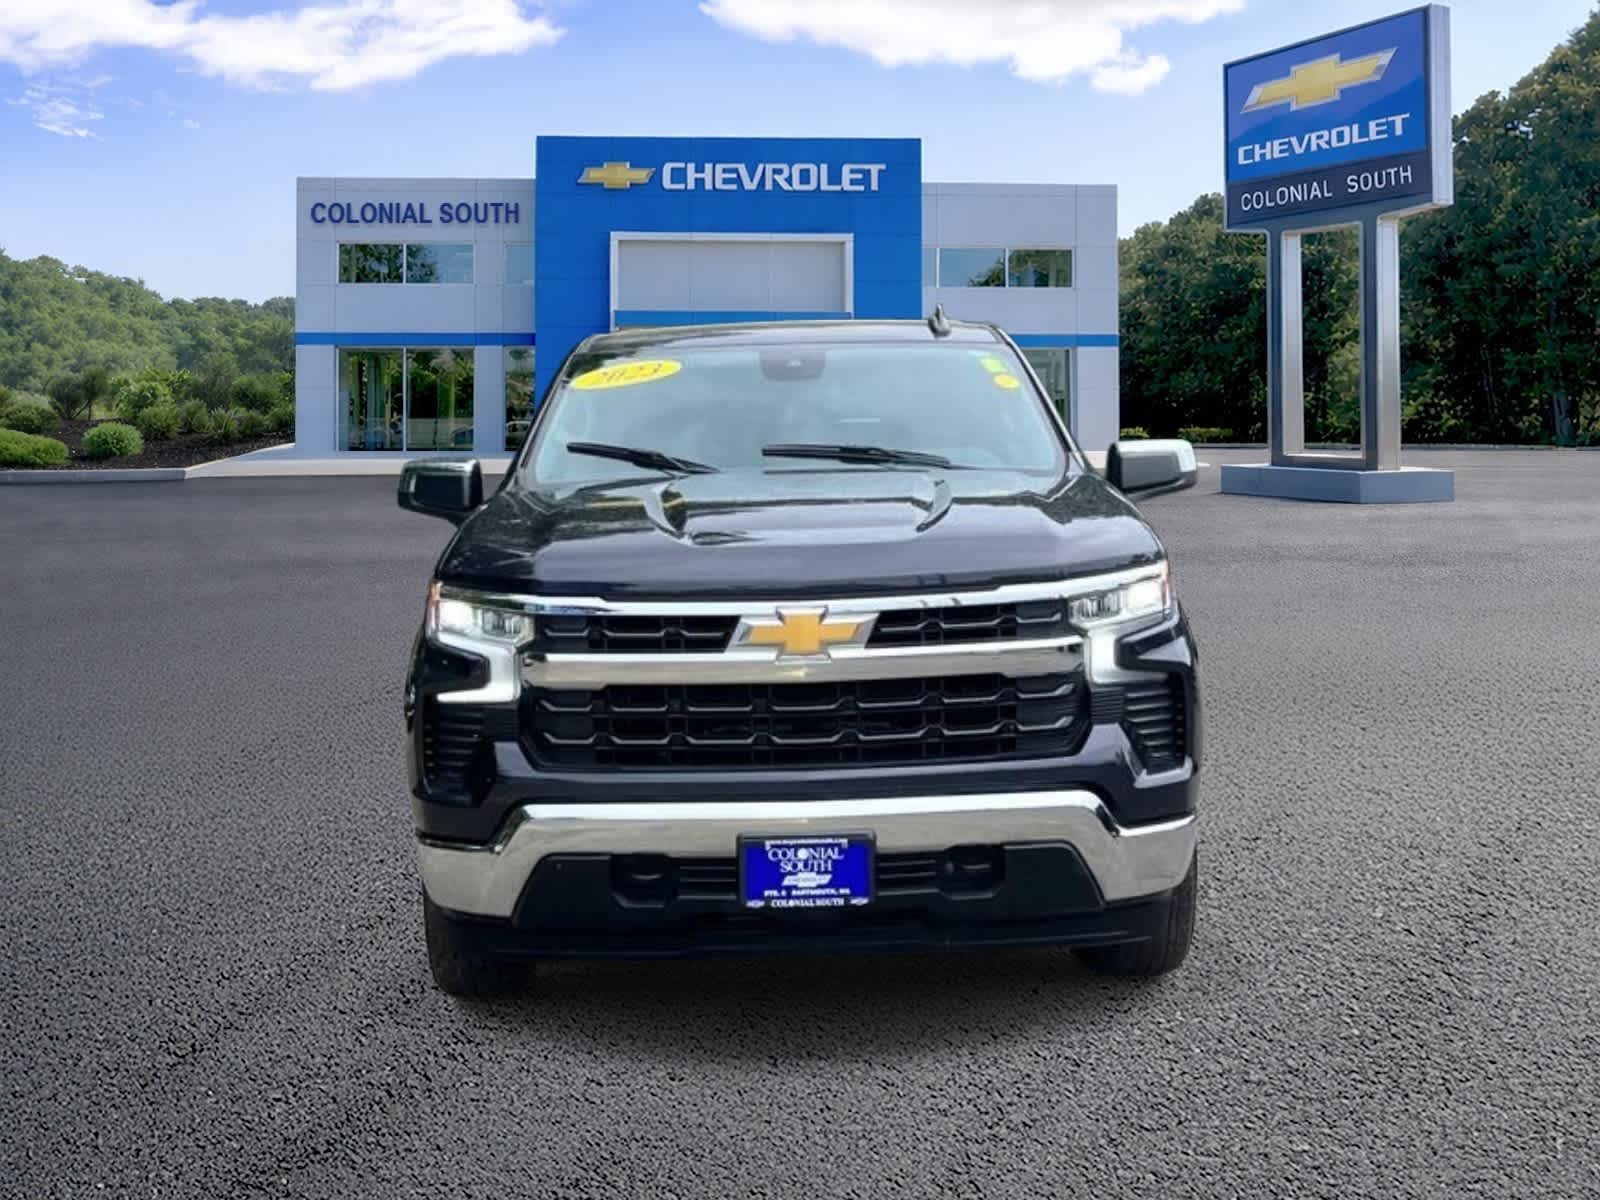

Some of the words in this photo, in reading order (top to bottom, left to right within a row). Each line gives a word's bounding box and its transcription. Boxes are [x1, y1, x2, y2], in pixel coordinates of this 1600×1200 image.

[1237, 112, 1410, 165] CHEVROLET
[662, 161, 887, 193] CHEVROLET
[1240, 179, 1333, 211] COLONIAL
[1346, 164, 1413, 193] SOUTH
[310, 202, 433, 224] COLONIAL
[439, 202, 520, 224] SOUTH
[767, 847, 845, 861] COLONIAL
[780, 859, 832, 873] SOUTH
